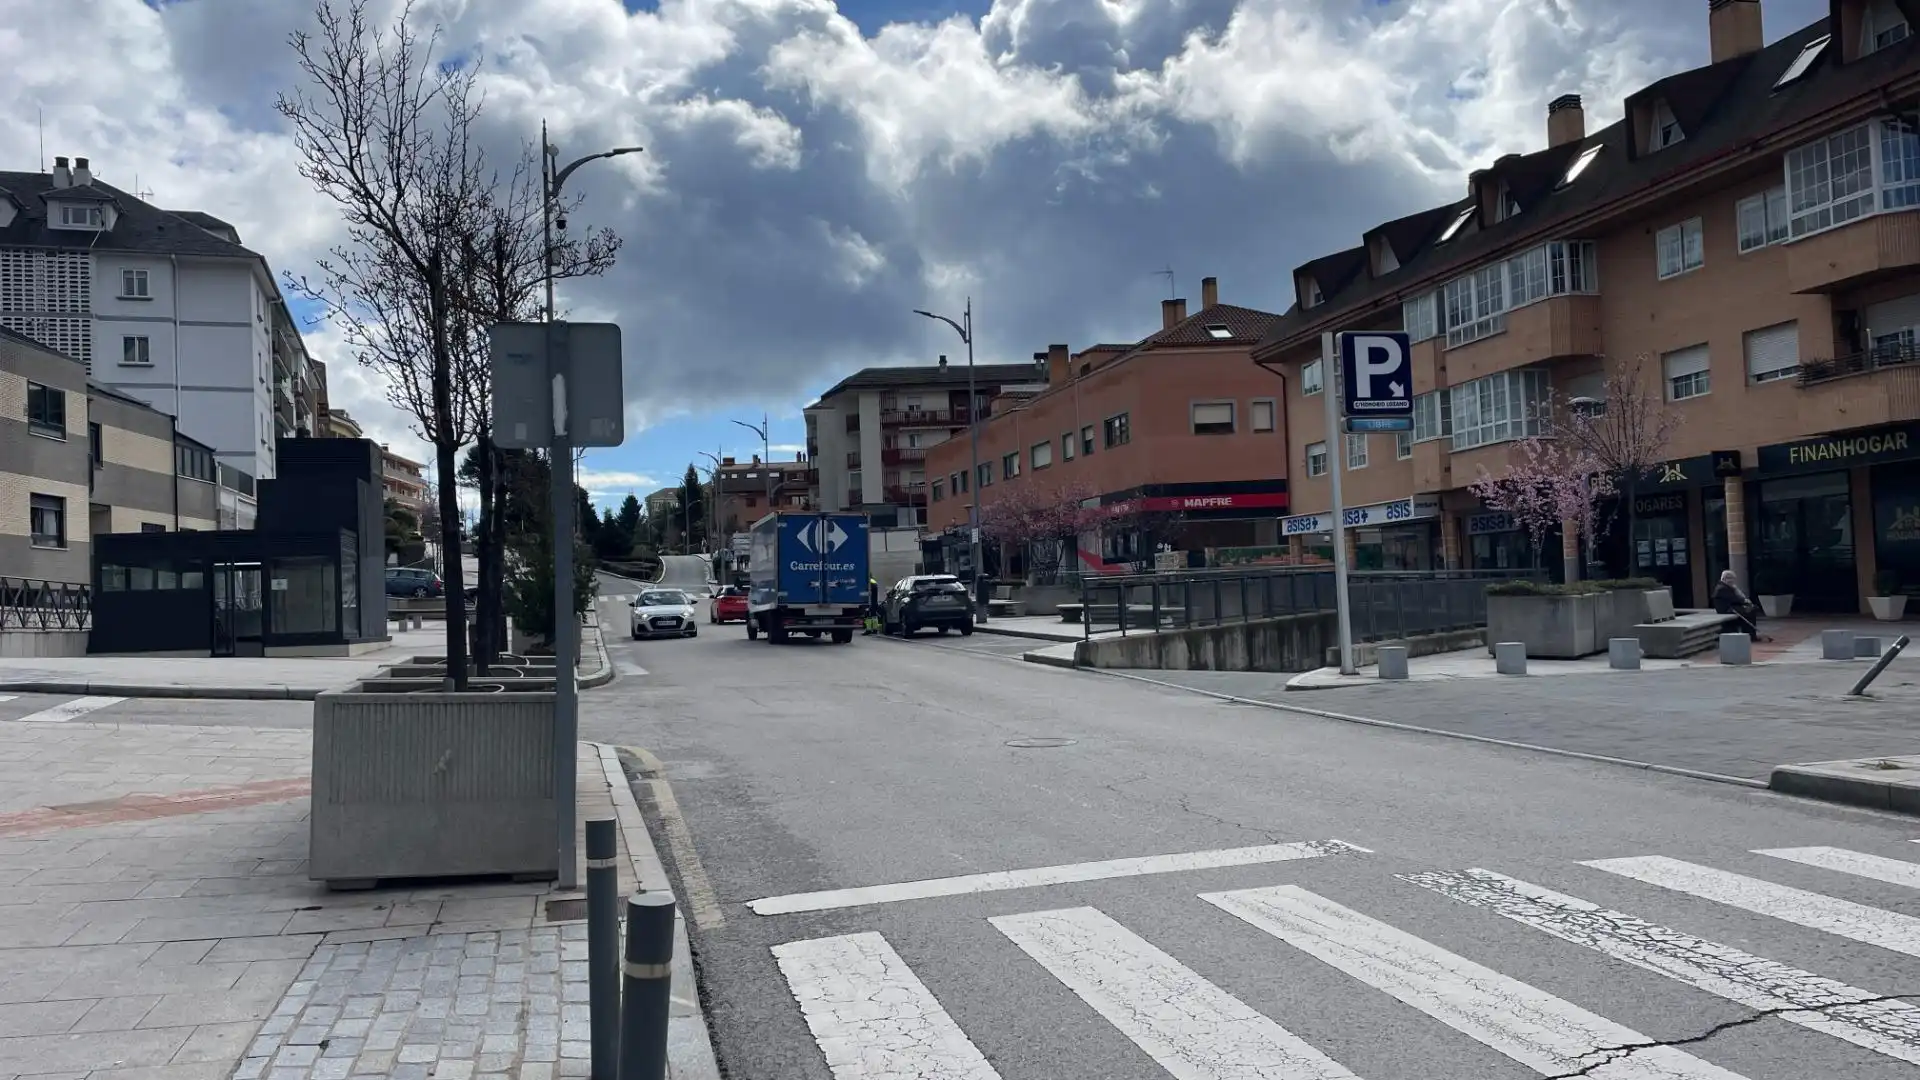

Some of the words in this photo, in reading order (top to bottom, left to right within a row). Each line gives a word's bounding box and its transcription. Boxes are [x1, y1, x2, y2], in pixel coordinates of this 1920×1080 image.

[1354, 336, 1402, 398] P
[1790, 431, 1908, 465] FINANHOGAR
[1184, 497, 1232, 508] MAPFRE
[1386, 502, 1411, 519] asis
[1636, 494, 1683, 513] OGARES
[1287, 518, 1311, 533] asisa
[1470, 514, 1505, 532] asisa
[790, 560, 855, 572] Carrefour.es
